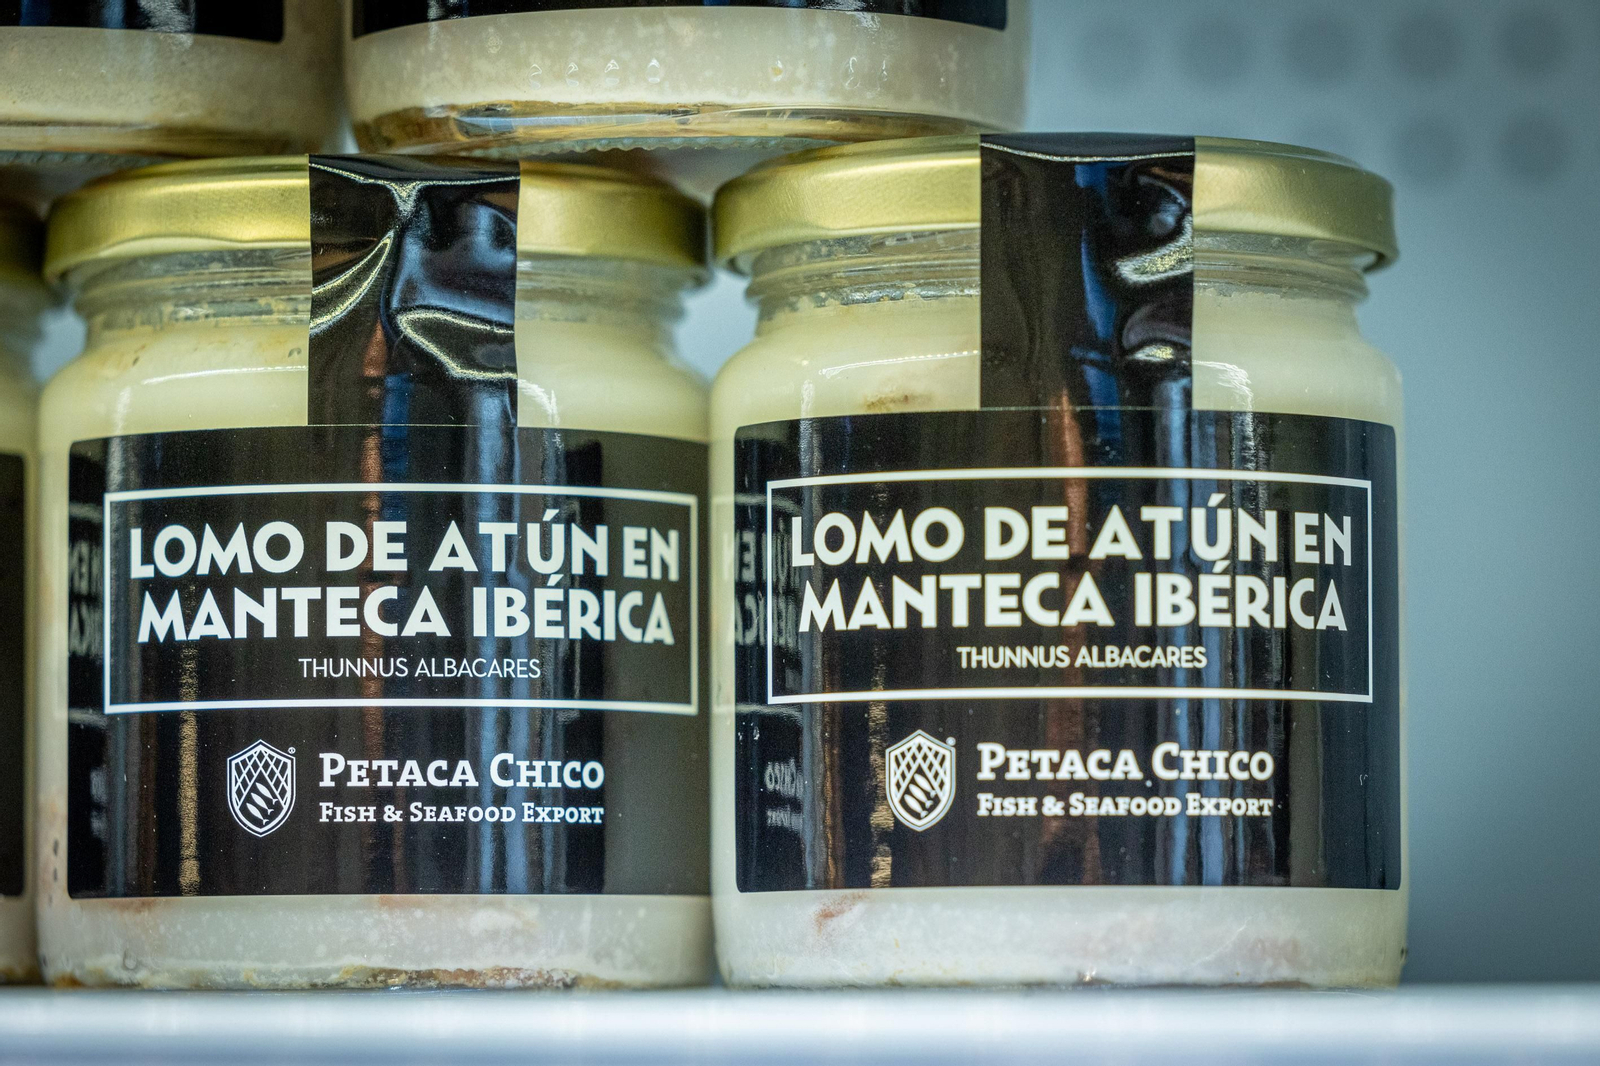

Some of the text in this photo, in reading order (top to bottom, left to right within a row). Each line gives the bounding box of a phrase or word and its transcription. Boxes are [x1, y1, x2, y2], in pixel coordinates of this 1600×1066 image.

[130, 521, 304, 578] LOMO
[326, 521, 408, 572] DE
[429, 509, 608, 577] ATÚN
[623, 526, 679, 582] EN
[792, 507, 964, 567] LOMO
[985, 505, 1069, 561] DE
[1089, 494, 1278, 564] ATÚN
[1295, 512, 1352, 566] EN
[137, 584, 450, 643] MANTECA
[472, 574, 675, 646] IBÉRICA
[799, 571, 1114, 632] MANTECA
[1134, 560, 1347, 631] IBÉRICA
[298, 657, 541, 679] THUNNUS ALBACARES
[957, 645, 1207, 669] THUNNUS ALBACARES
[383, 804, 403, 823] &
[1042, 794, 1065, 816] &
